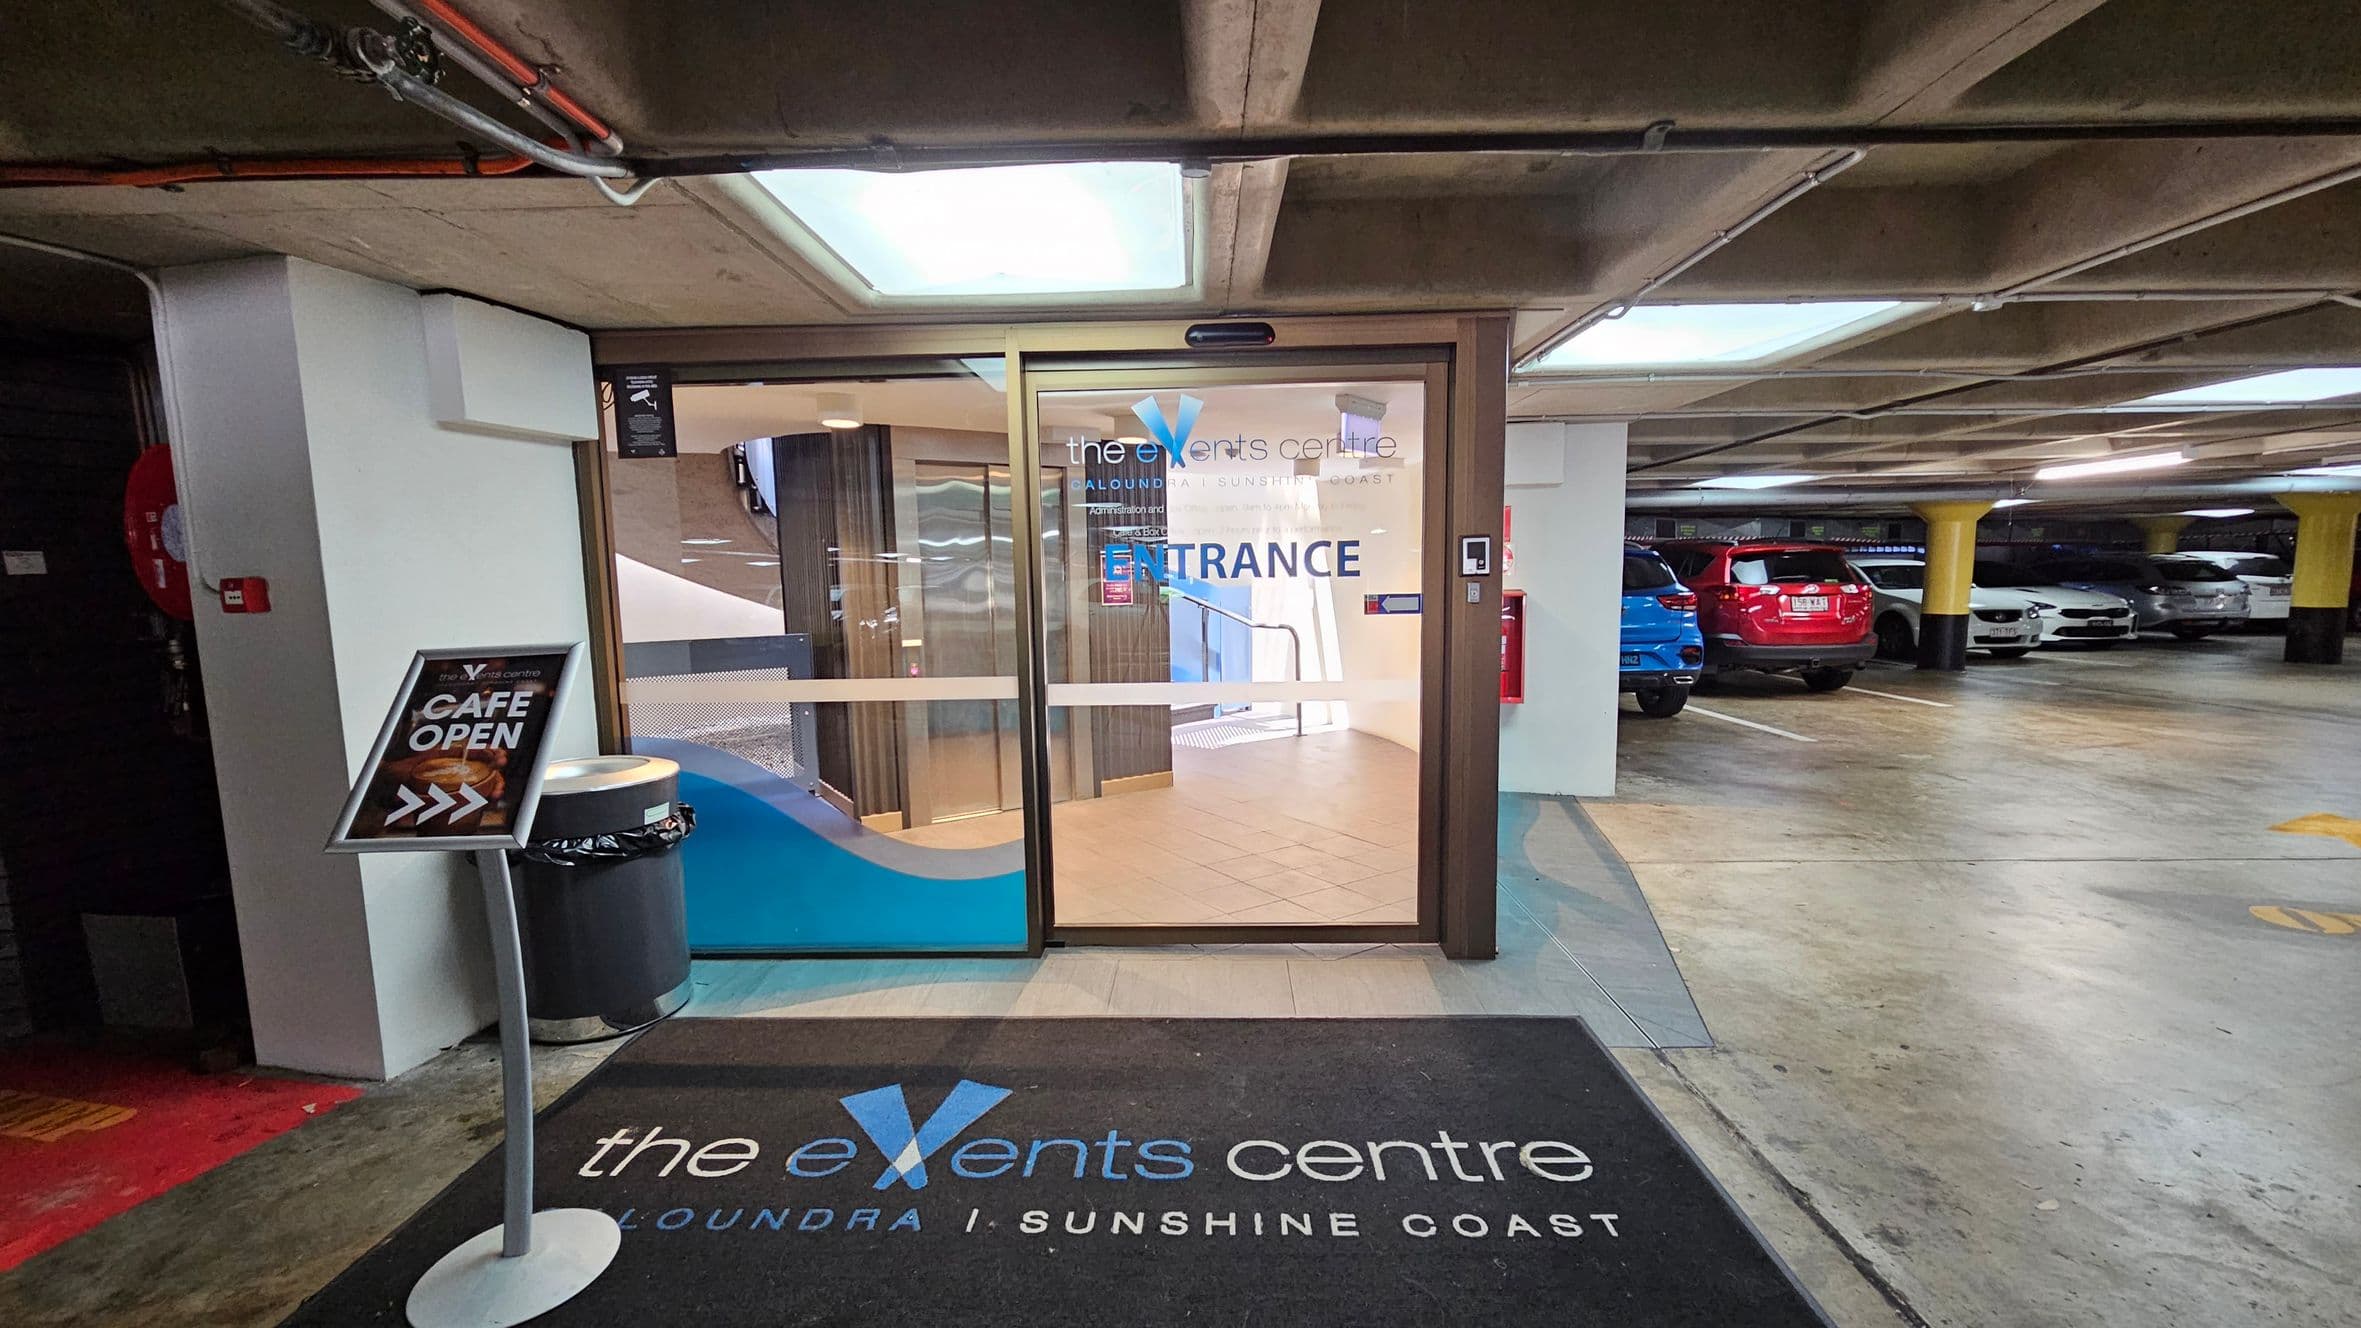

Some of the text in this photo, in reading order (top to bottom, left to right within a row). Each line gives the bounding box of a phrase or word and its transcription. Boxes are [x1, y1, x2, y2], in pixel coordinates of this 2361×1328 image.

[1066, 434, 1126, 465] the
[1279, 432, 1397, 461] centre
[1071, 478, 1191, 490] CALOUNDRA
[1218, 475, 1313, 488] SUNSHIN
[1330, 473, 1394, 486] COAST
[1089, 505, 1147, 516] Administration
[1148, 505, 1165, 515] and
[1104, 540, 1361, 582] ENTRANCE
[502, 669, 542, 679] centre
[422, 691, 534, 721] CAFE
[408, 722, 524, 752] OPEN
[577, 1126, 760, 1179] the
[1226, 1129, 1594, 1183] centre
[1019, 1210, 1360, 1237] SUNSHINE
[1402, 1212, 1620, 1238] COAST
